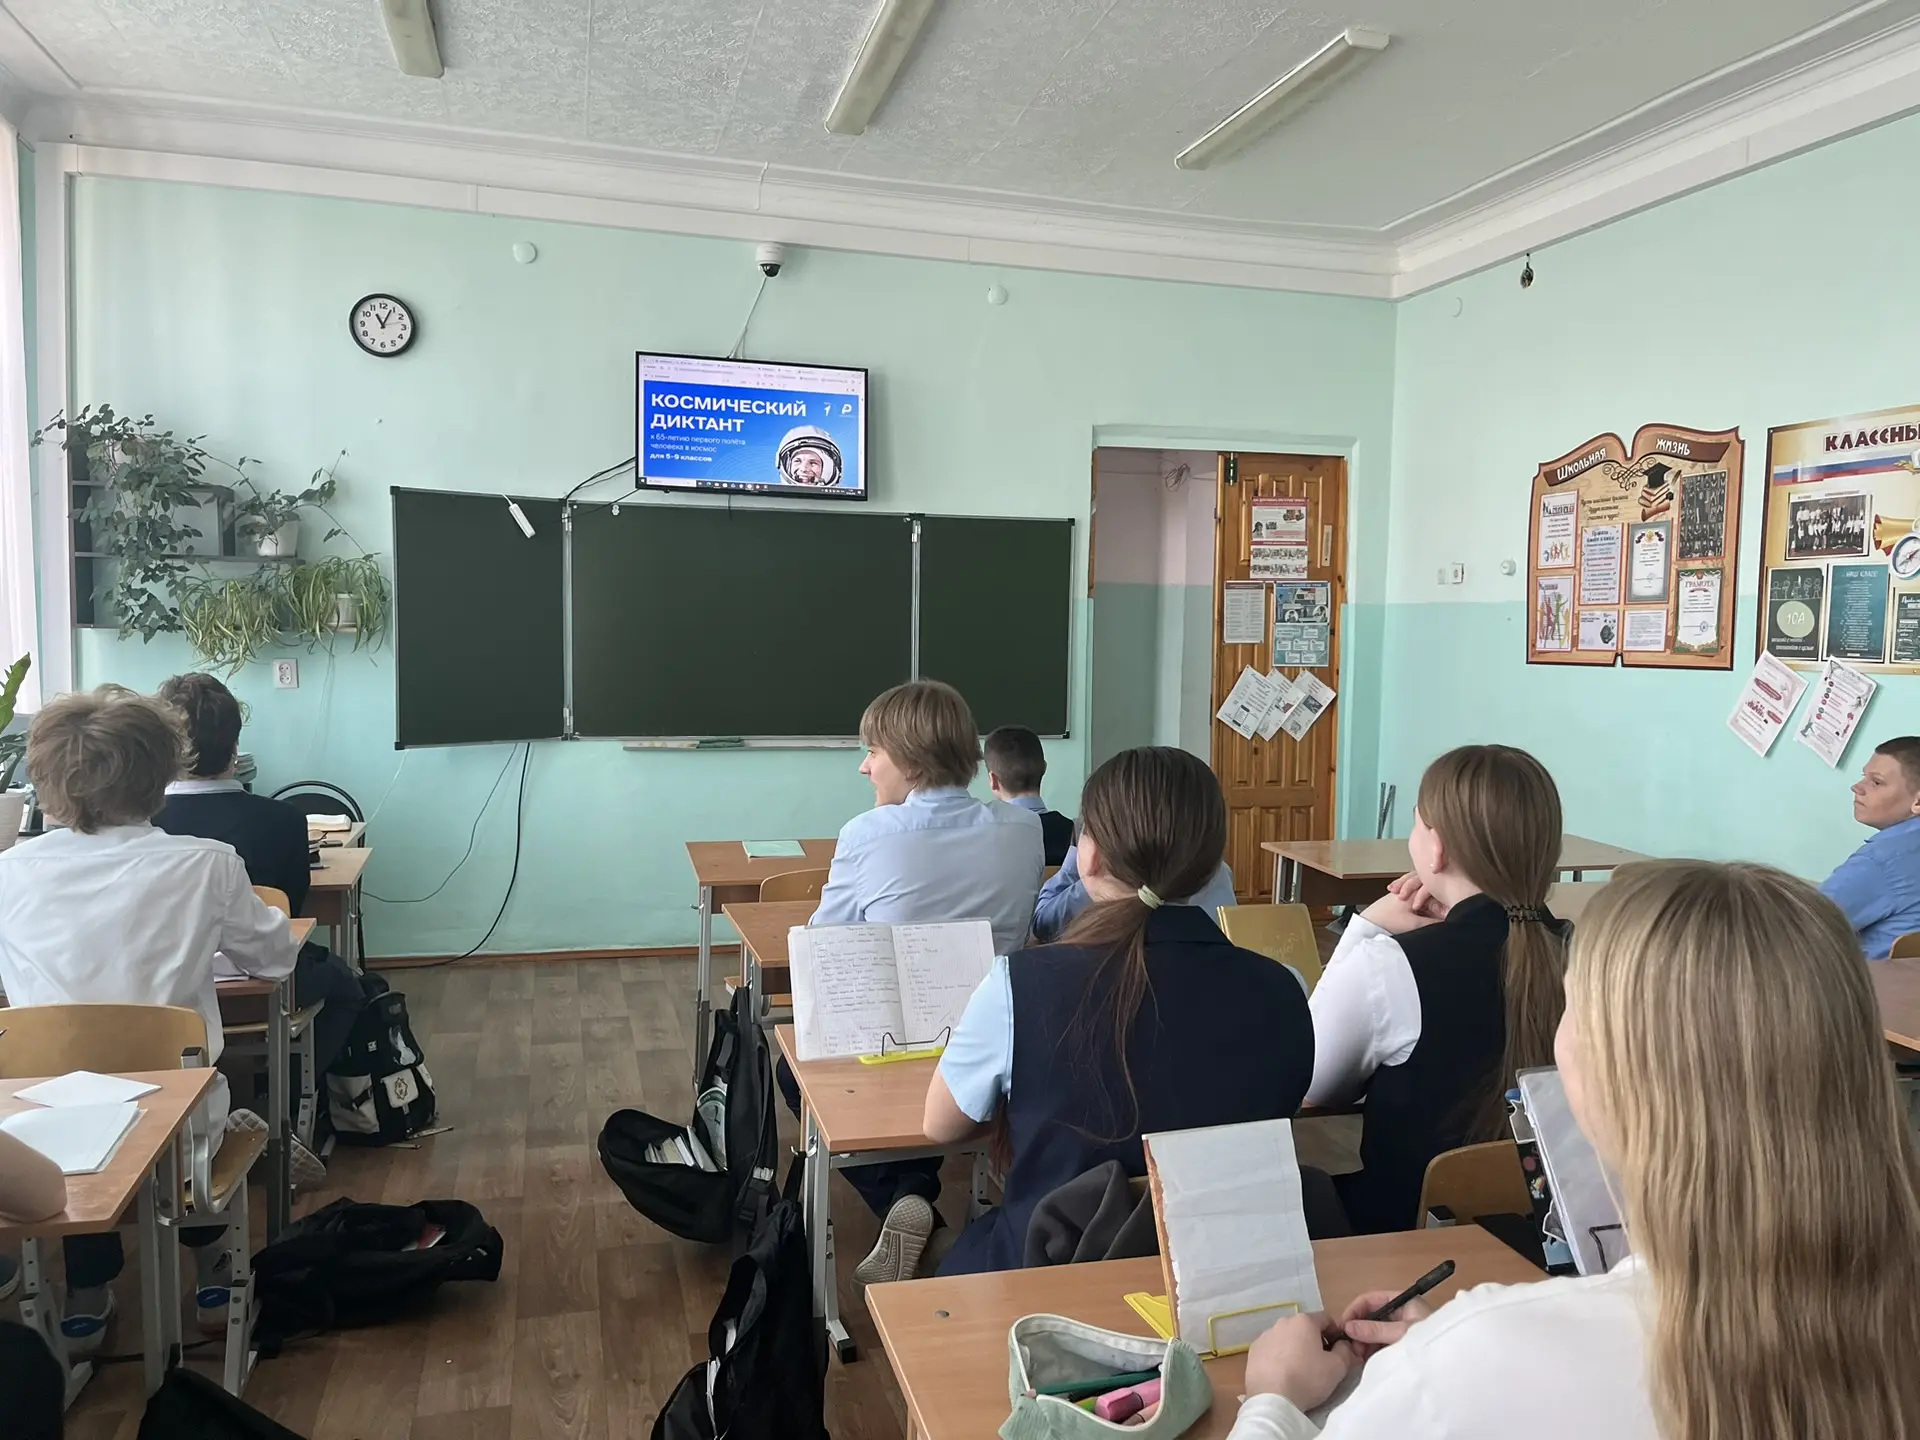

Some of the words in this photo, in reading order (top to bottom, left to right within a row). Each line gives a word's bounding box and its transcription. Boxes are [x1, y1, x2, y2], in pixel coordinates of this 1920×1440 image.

[651, 393, 806, 417] КОСМИЧЕСКИЙ
[650, 413, 744, 433] ДИКТАНТ
[656, 433, 690, 442] 65-летию
[691, 436, 720, 444] первого
[1684, 580, 1715, 588] ГРАМОТА
[1786, 612, 1805, 625] 10А
